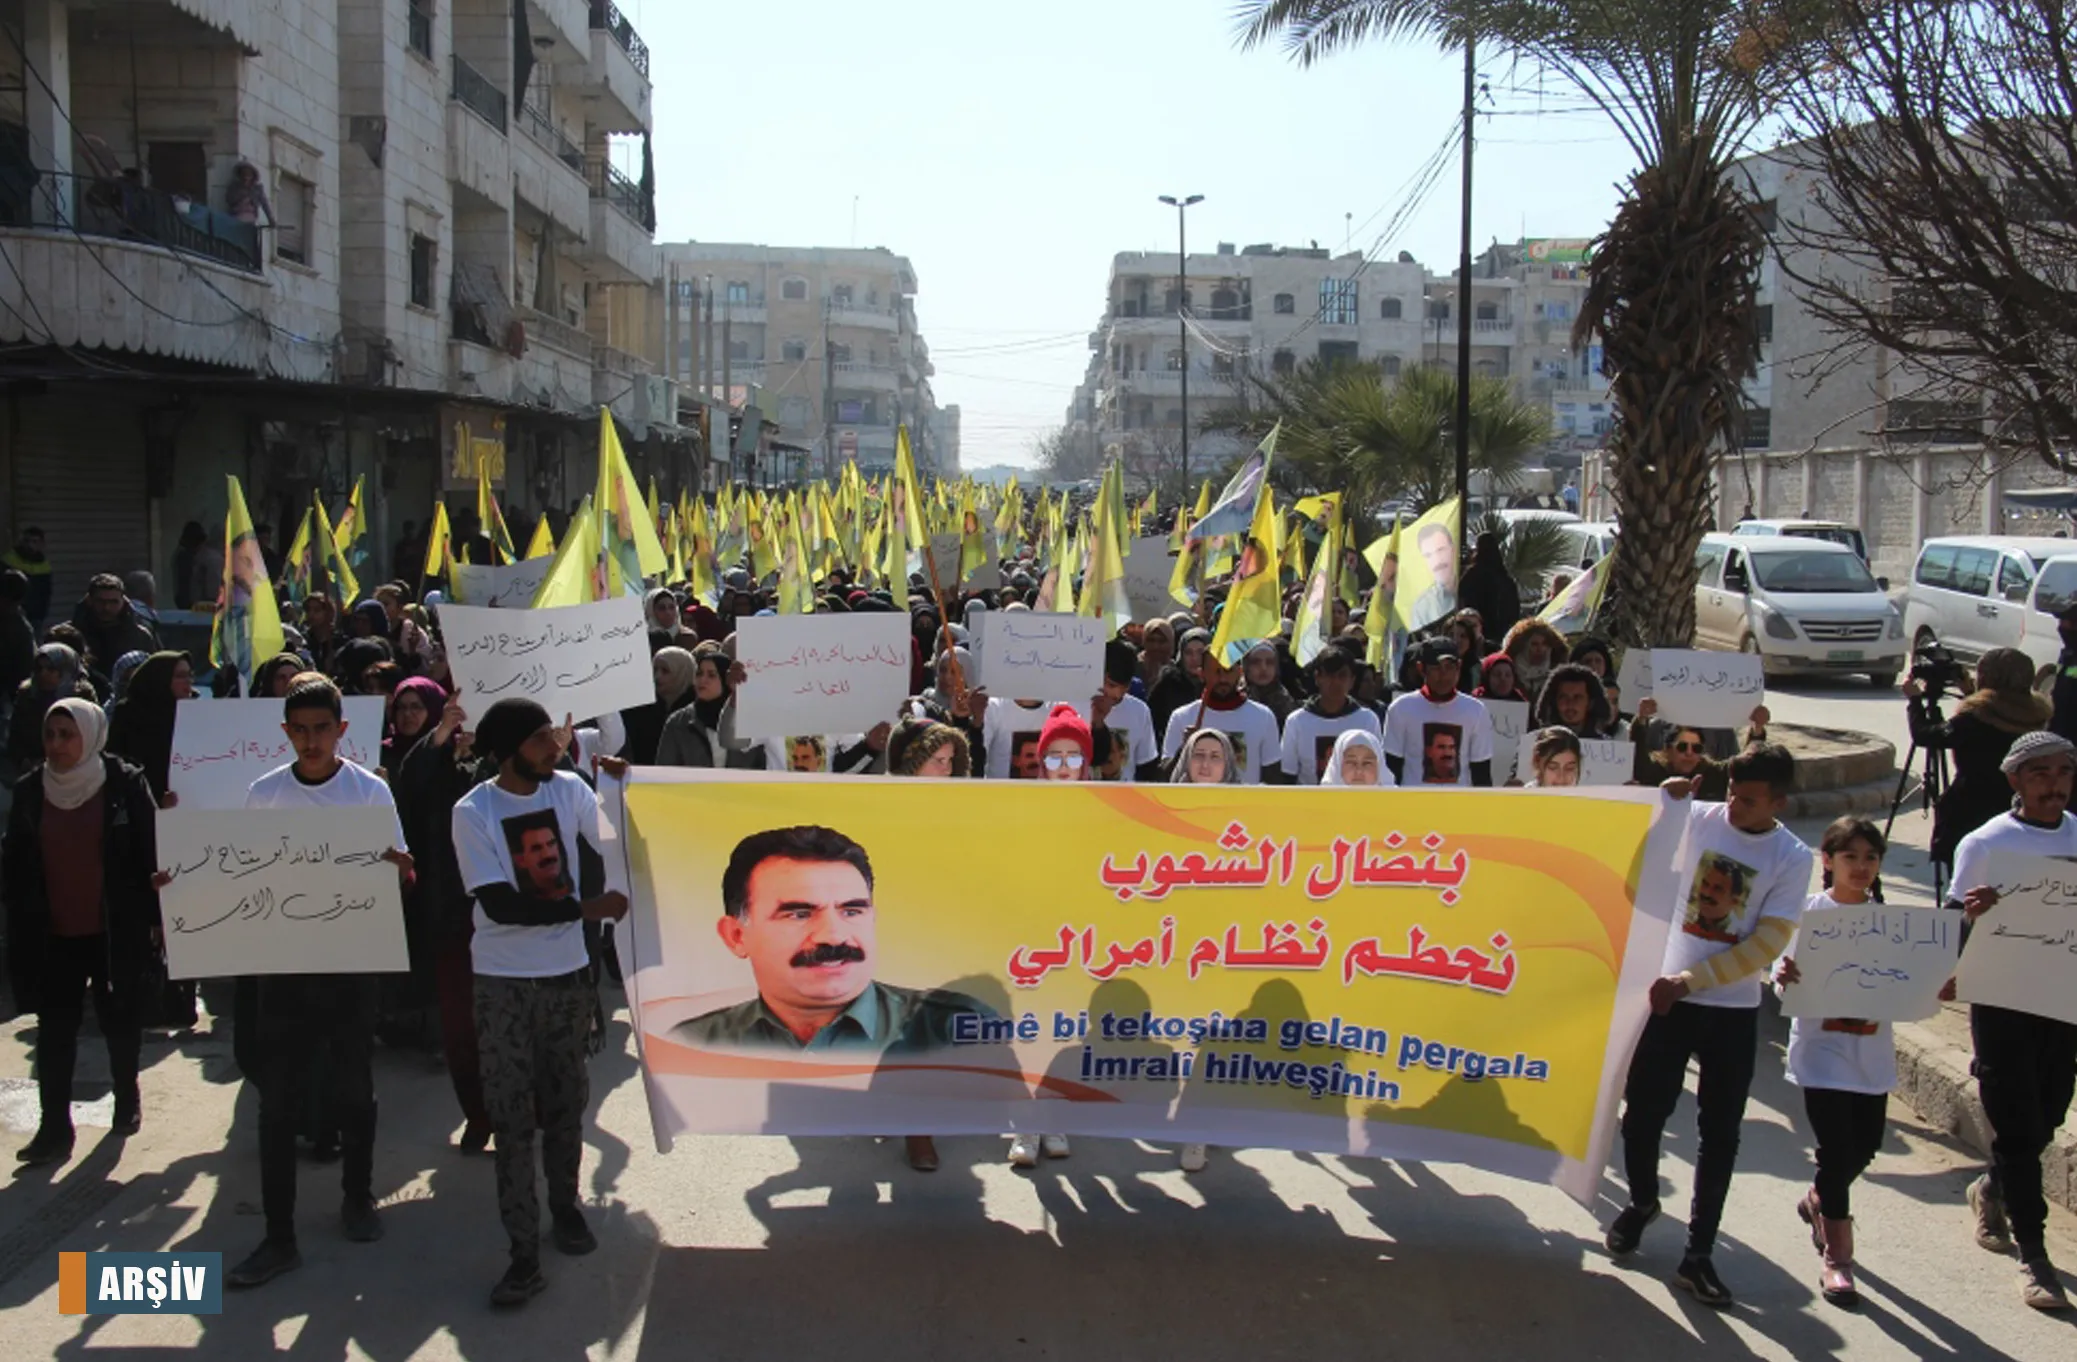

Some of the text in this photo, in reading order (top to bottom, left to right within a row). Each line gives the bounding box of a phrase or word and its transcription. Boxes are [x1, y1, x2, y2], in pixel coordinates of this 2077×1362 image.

[1100, 820, 1469, 905] بنضال الشعوب
[1007, 915, 1519, 994] نحطم نظام أمرالي
[953, 1011, 1549, 1084] Emê bi tekoşîna gelan pergala
[1080, 1051, 1401, 1102] İmralî hilweşînin
